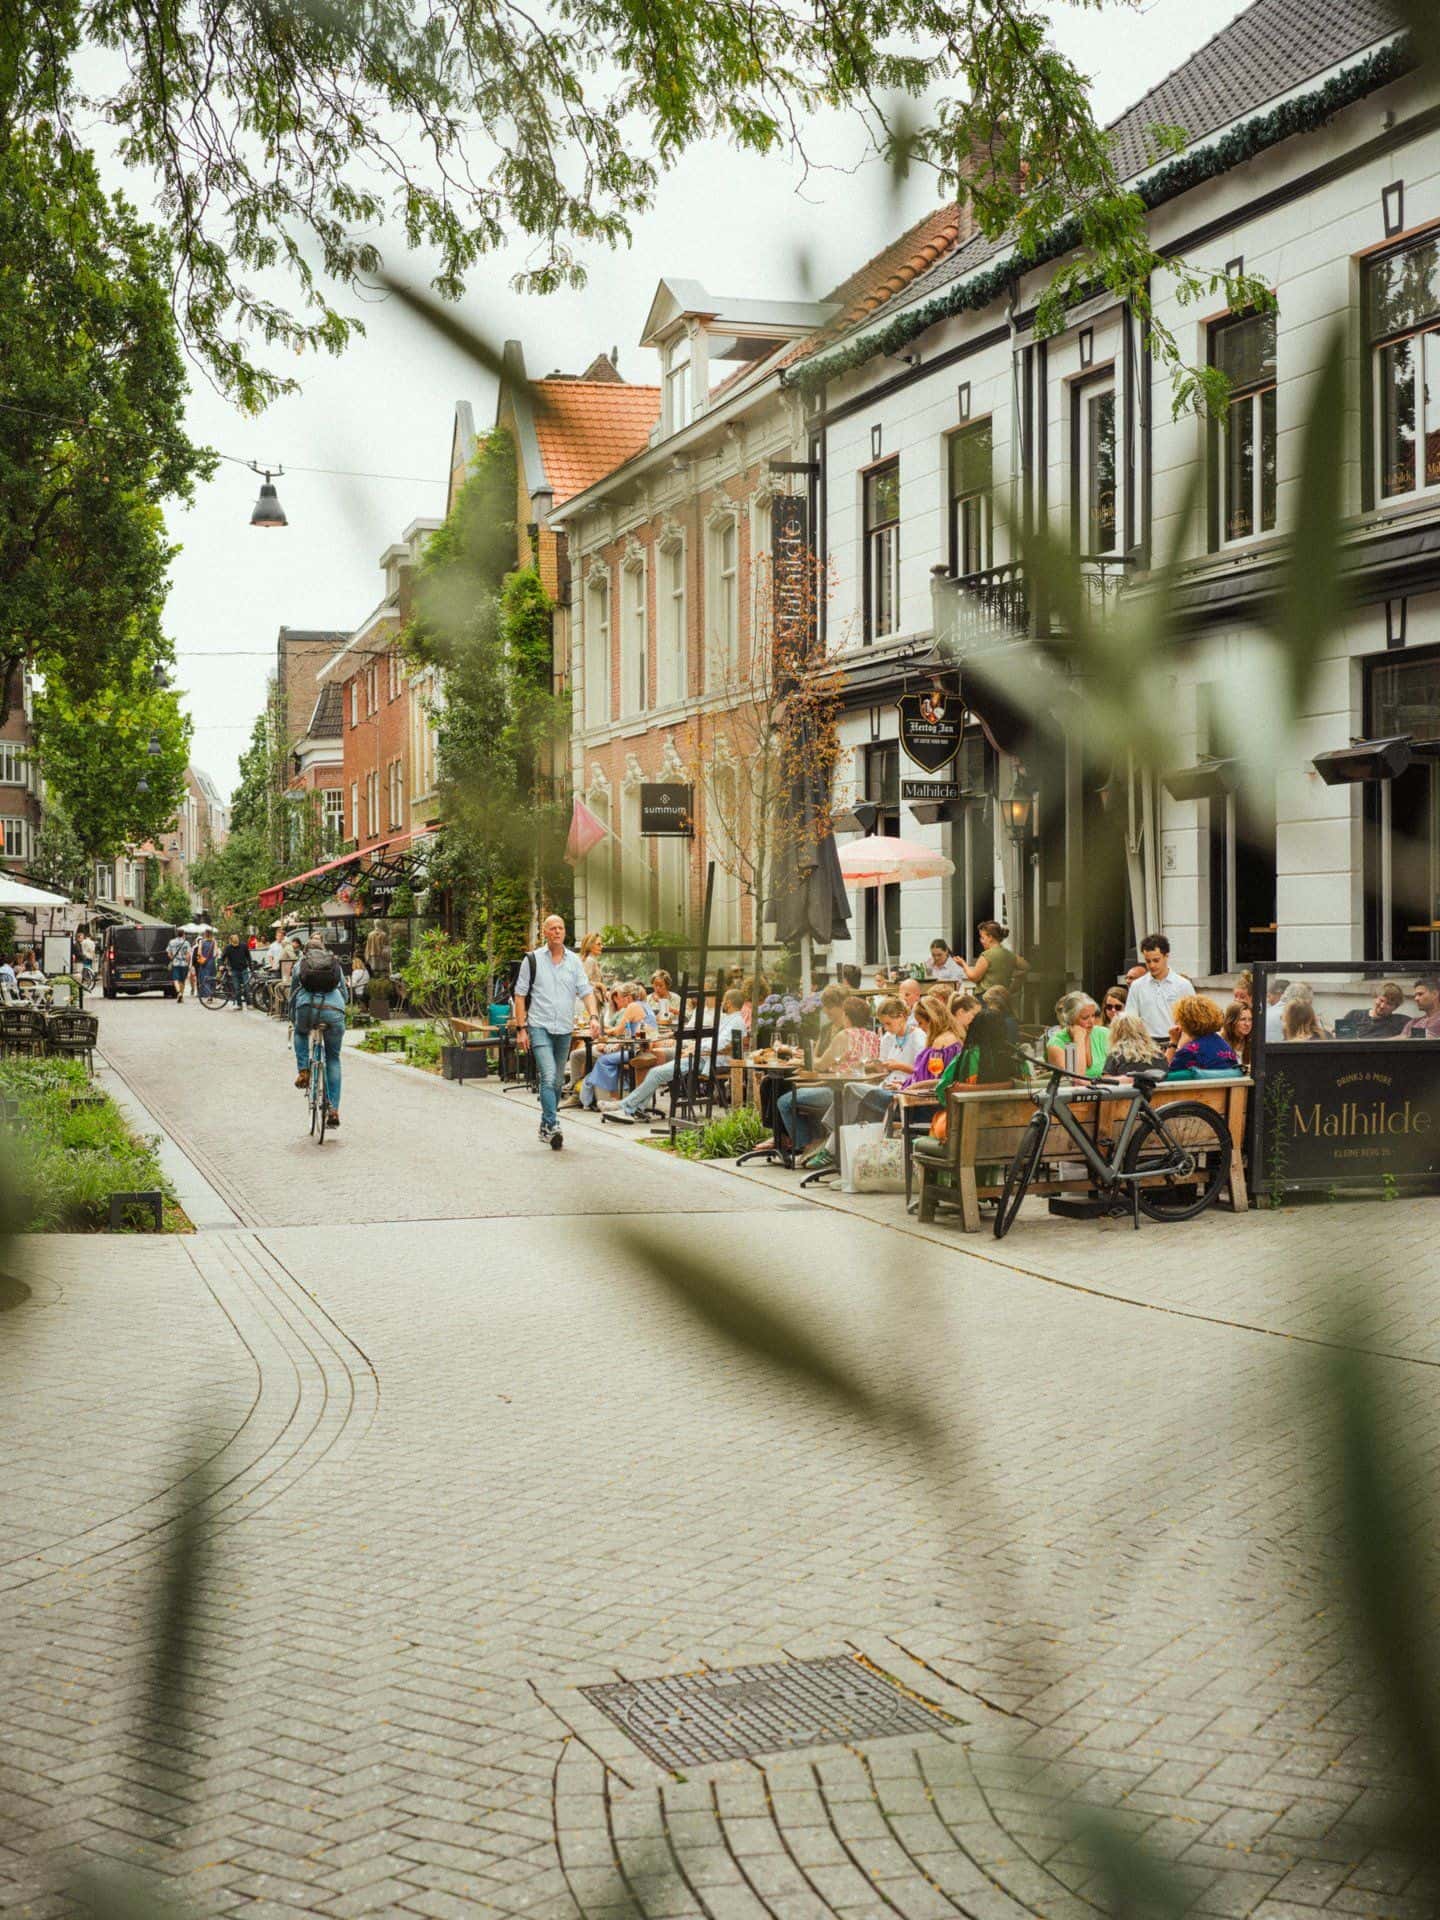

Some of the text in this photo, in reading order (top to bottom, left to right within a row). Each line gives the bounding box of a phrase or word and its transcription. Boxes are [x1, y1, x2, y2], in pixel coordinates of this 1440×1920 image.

[644, 806, 687, 815] summum
[1336, 1071, 1363, 1087] DRINKS
[1372, 1072, 1392, 1086] MORE
